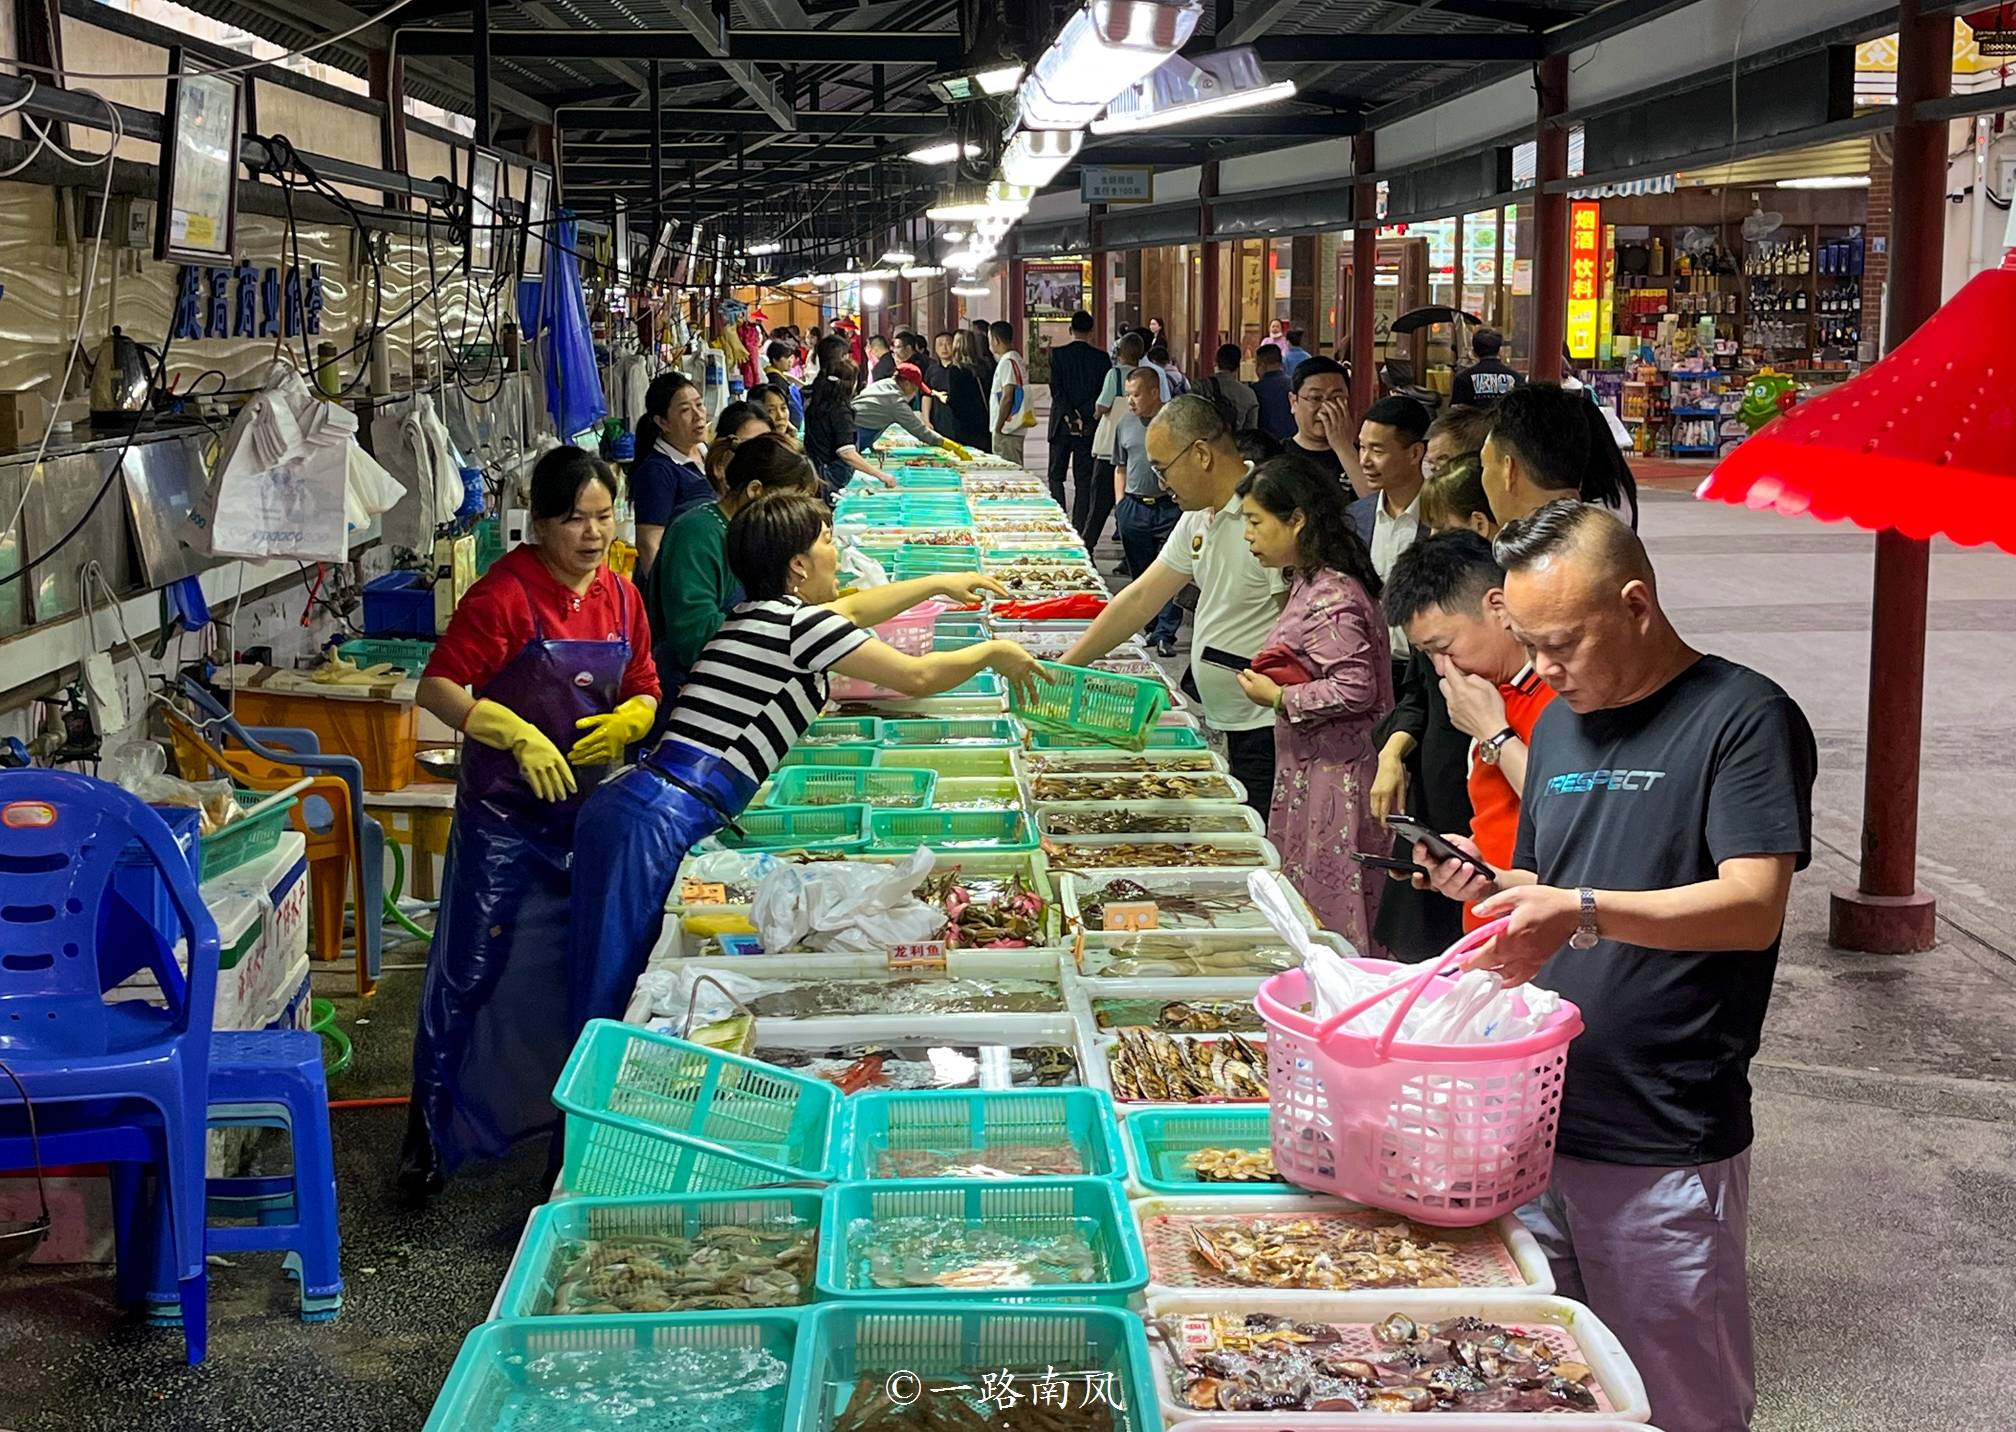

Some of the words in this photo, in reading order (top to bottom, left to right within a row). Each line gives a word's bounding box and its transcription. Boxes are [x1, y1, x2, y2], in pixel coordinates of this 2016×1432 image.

[1574, 210, 1596, 249] 烟酒
[1572, 258, 1594, 299] 饮料
[1544, 769, 1666, 797] RESPECT
[894, 944, 940, 958] 龙利鱼
